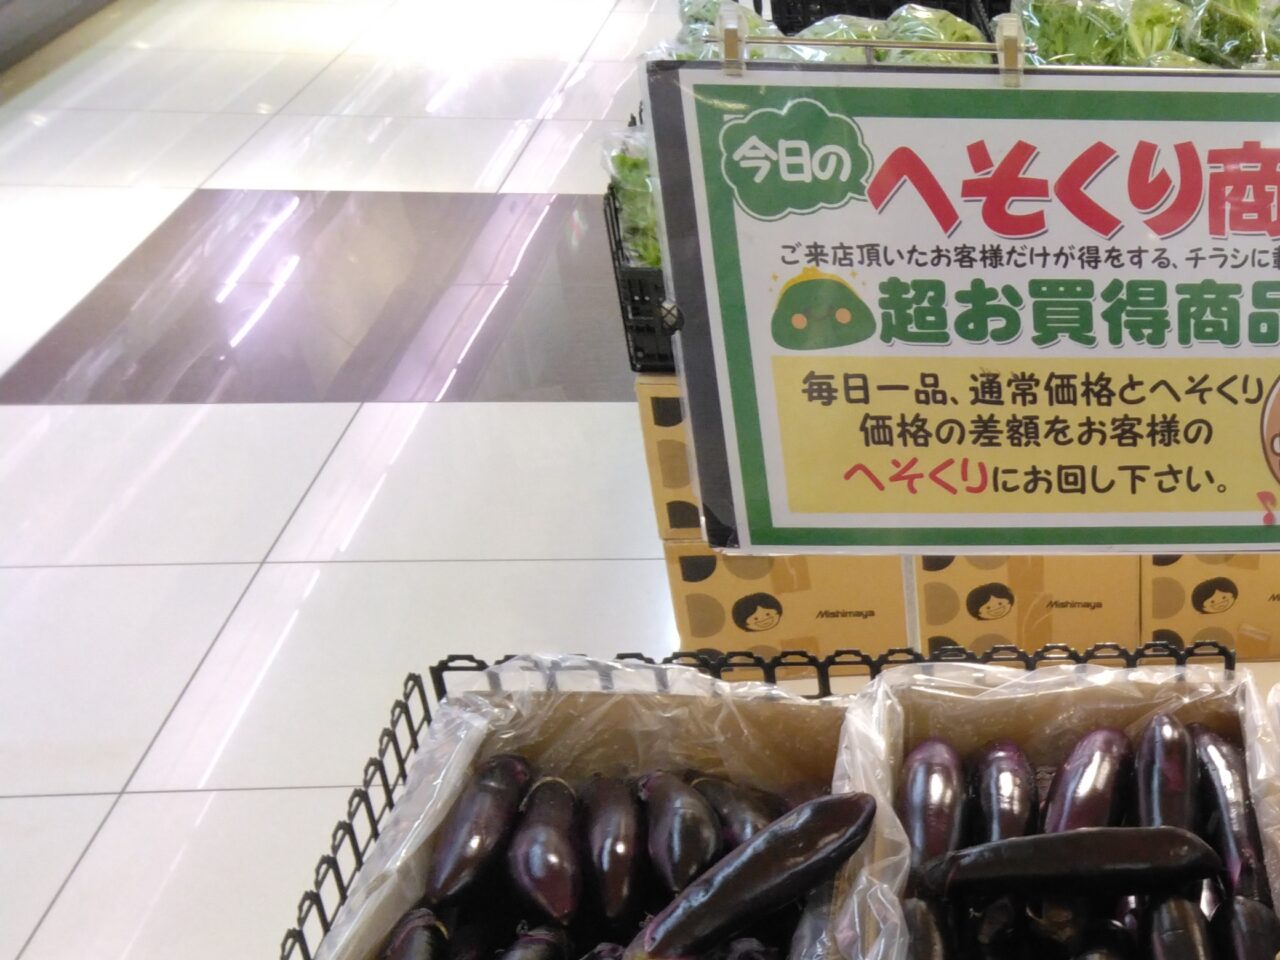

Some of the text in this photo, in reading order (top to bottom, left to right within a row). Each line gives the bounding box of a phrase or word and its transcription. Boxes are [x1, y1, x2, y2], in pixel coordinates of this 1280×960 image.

[732, 141, 852, 187] 今日の
[801, 370, 1265, 407] 毎日一品、通常価格とへそくり
[858, 412, 1213, 447] 価格の差額をお客様の
[816, 608, 875, 620] Mishimaya
[1046, 600, 1103, 610] Mishimaya
